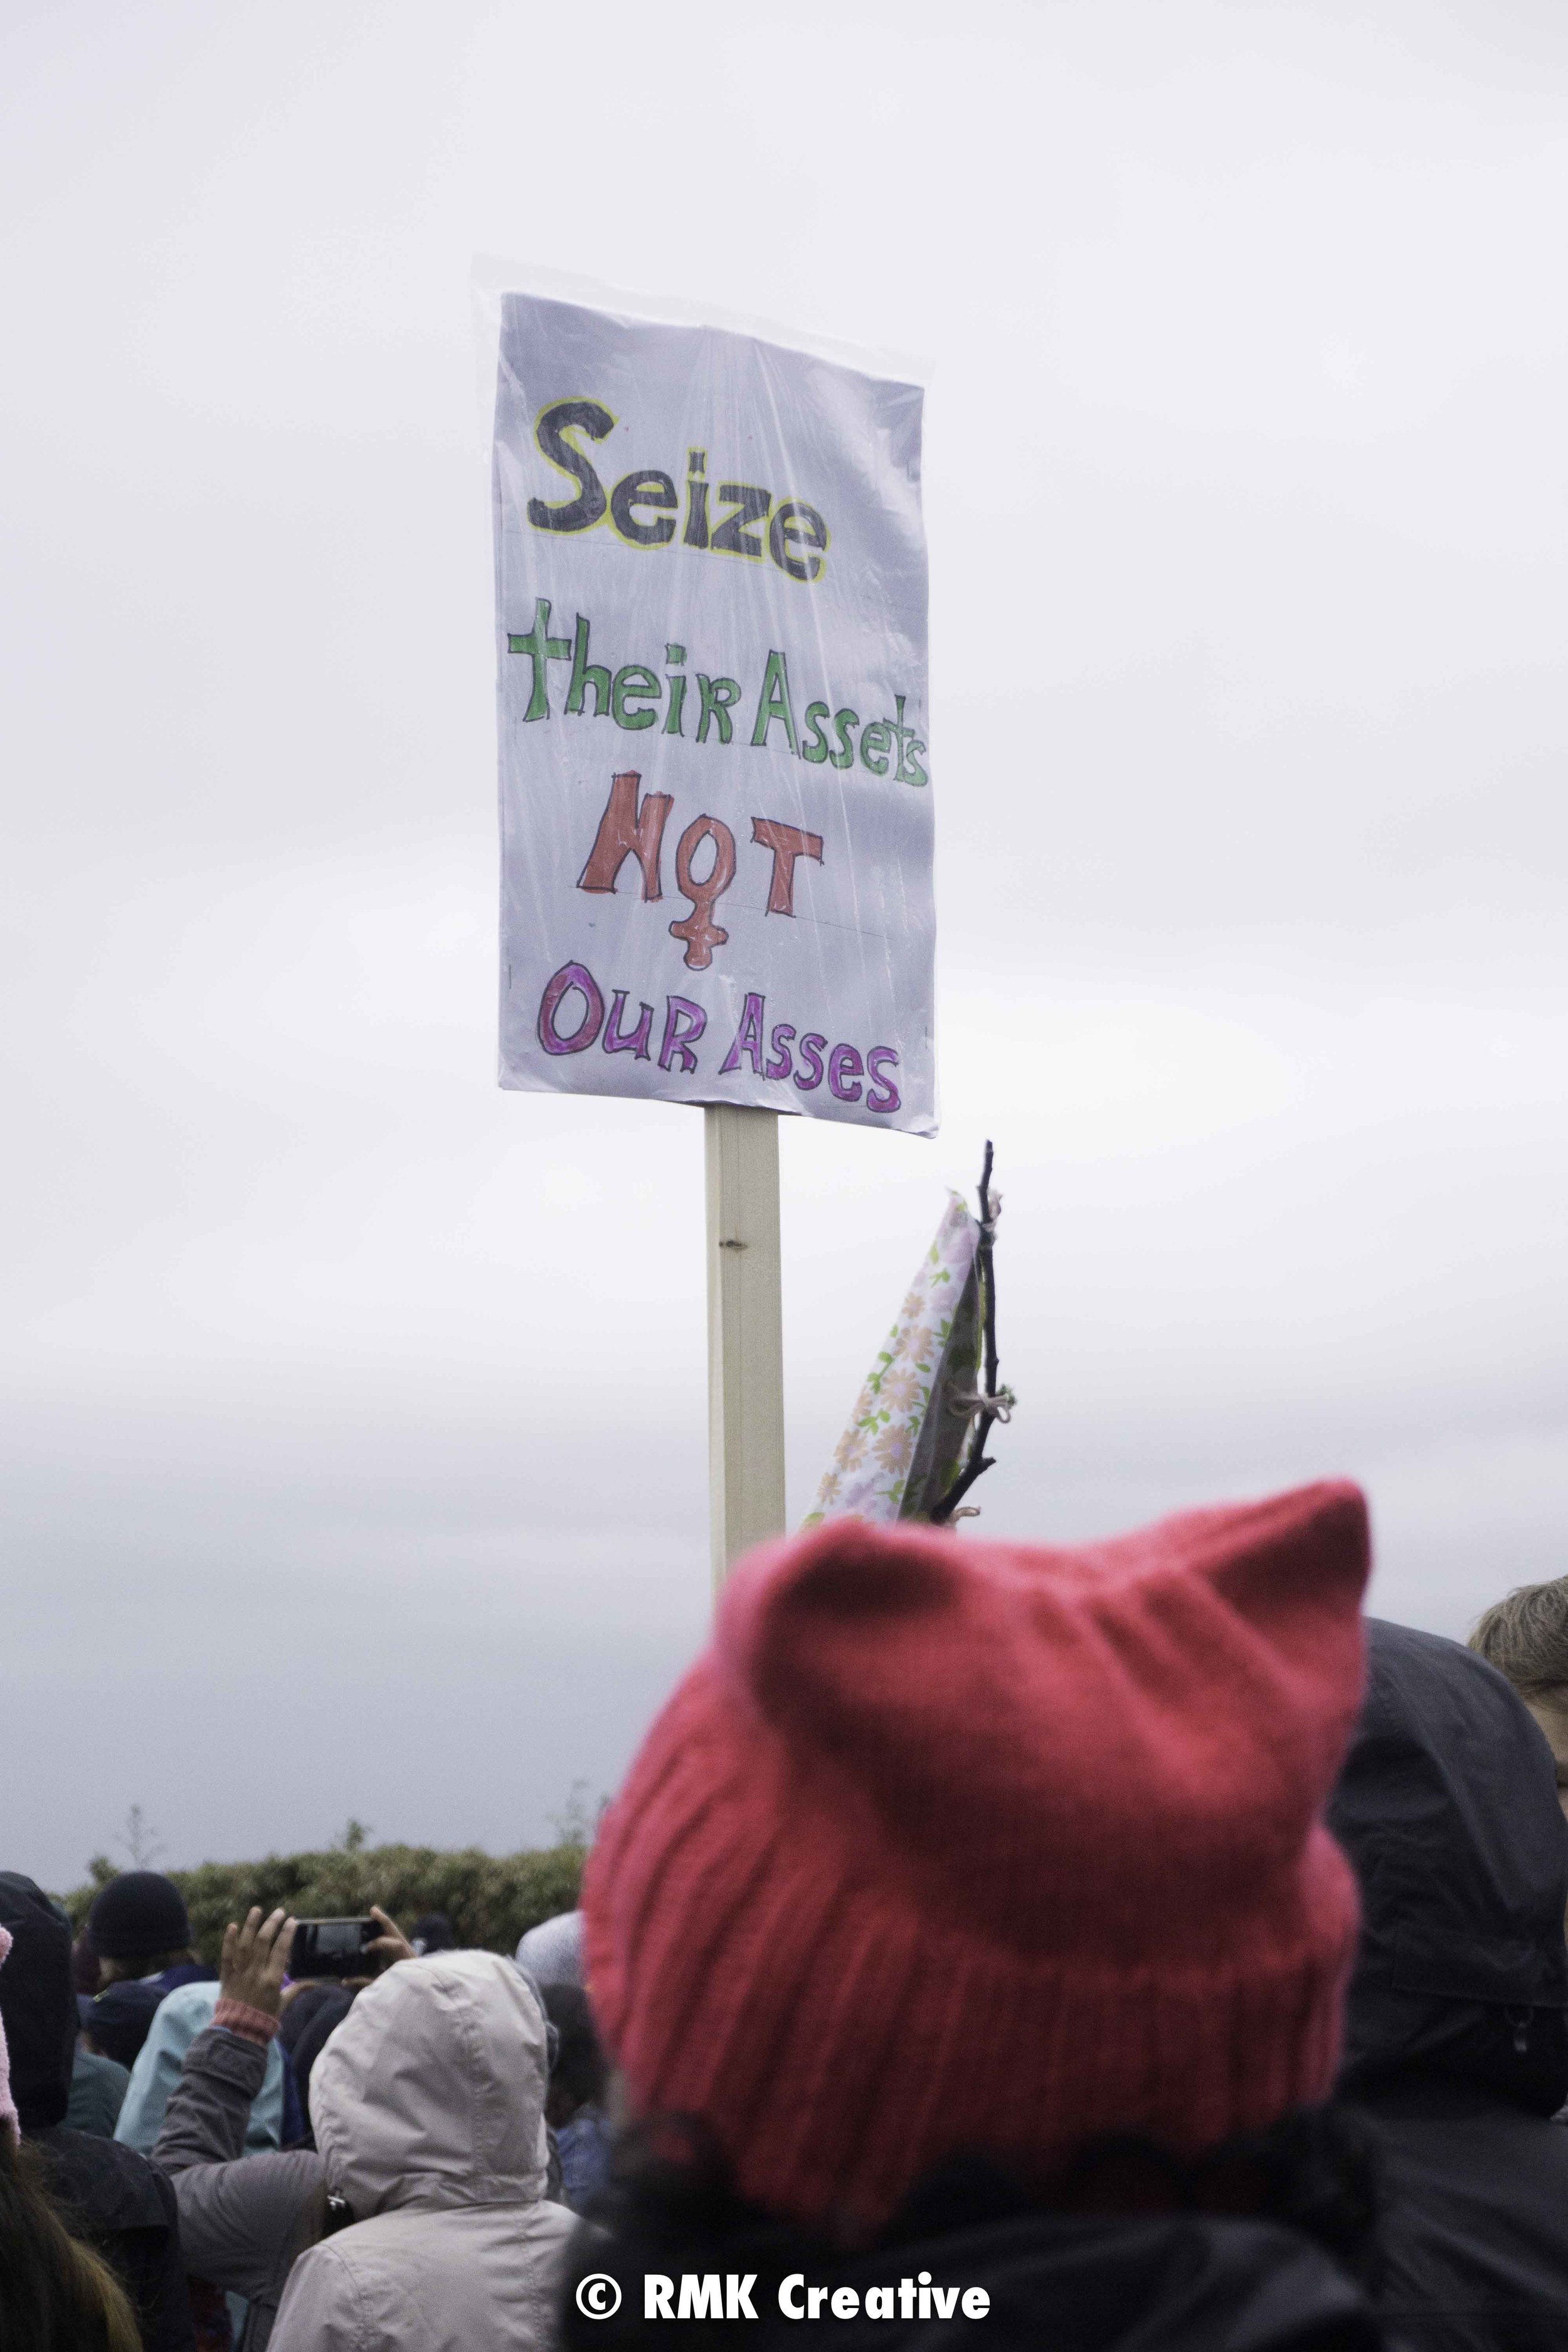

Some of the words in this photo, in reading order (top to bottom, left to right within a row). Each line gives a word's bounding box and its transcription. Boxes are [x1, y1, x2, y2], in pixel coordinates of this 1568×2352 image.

[526, 396, 831, 582] Seize
[751, 649, 929, 787] Assets
[576, 770, 824, 971] NOT
[719, 992, 902, 1113] Asses
